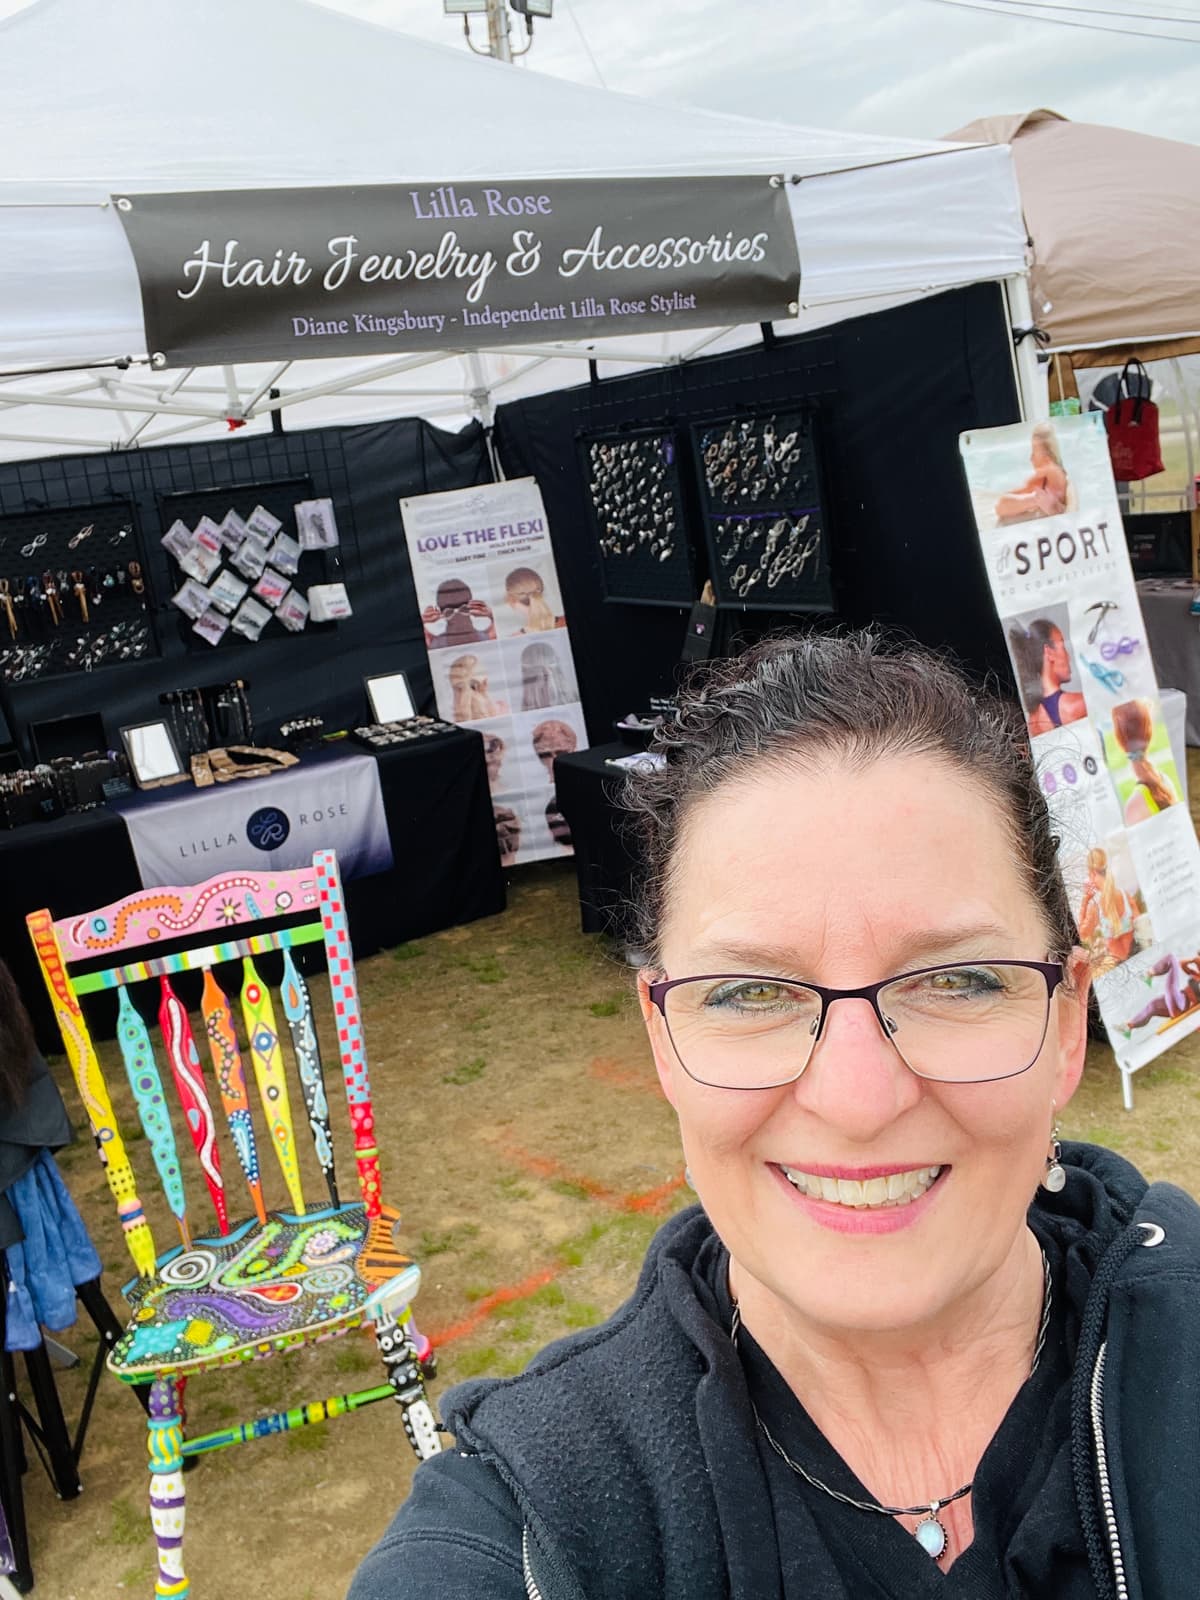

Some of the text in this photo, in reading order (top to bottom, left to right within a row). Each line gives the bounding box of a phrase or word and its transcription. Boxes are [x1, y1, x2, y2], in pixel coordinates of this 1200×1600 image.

[410, 187, 552, 219] Lilla Rose
[177, 226, 769, 303] Hair Jewelry & Accessories
[292, 317, 349, 337] Diane
[353, 311, 446, 336] Kingsbury
[462, 304, 567, 328] Independent
[570, 299, 606, 319] Lilla
[610, 297, 646, 316] Rose
[650, 290, 697, 316] Stylist
[417, 518, 544, 553] LOVE THE FLEXI
[1014, 523, 1112, 575] SPORT
[180, 833, 237, 857] LILLA
[299, 803, 348, 825] ROSE
